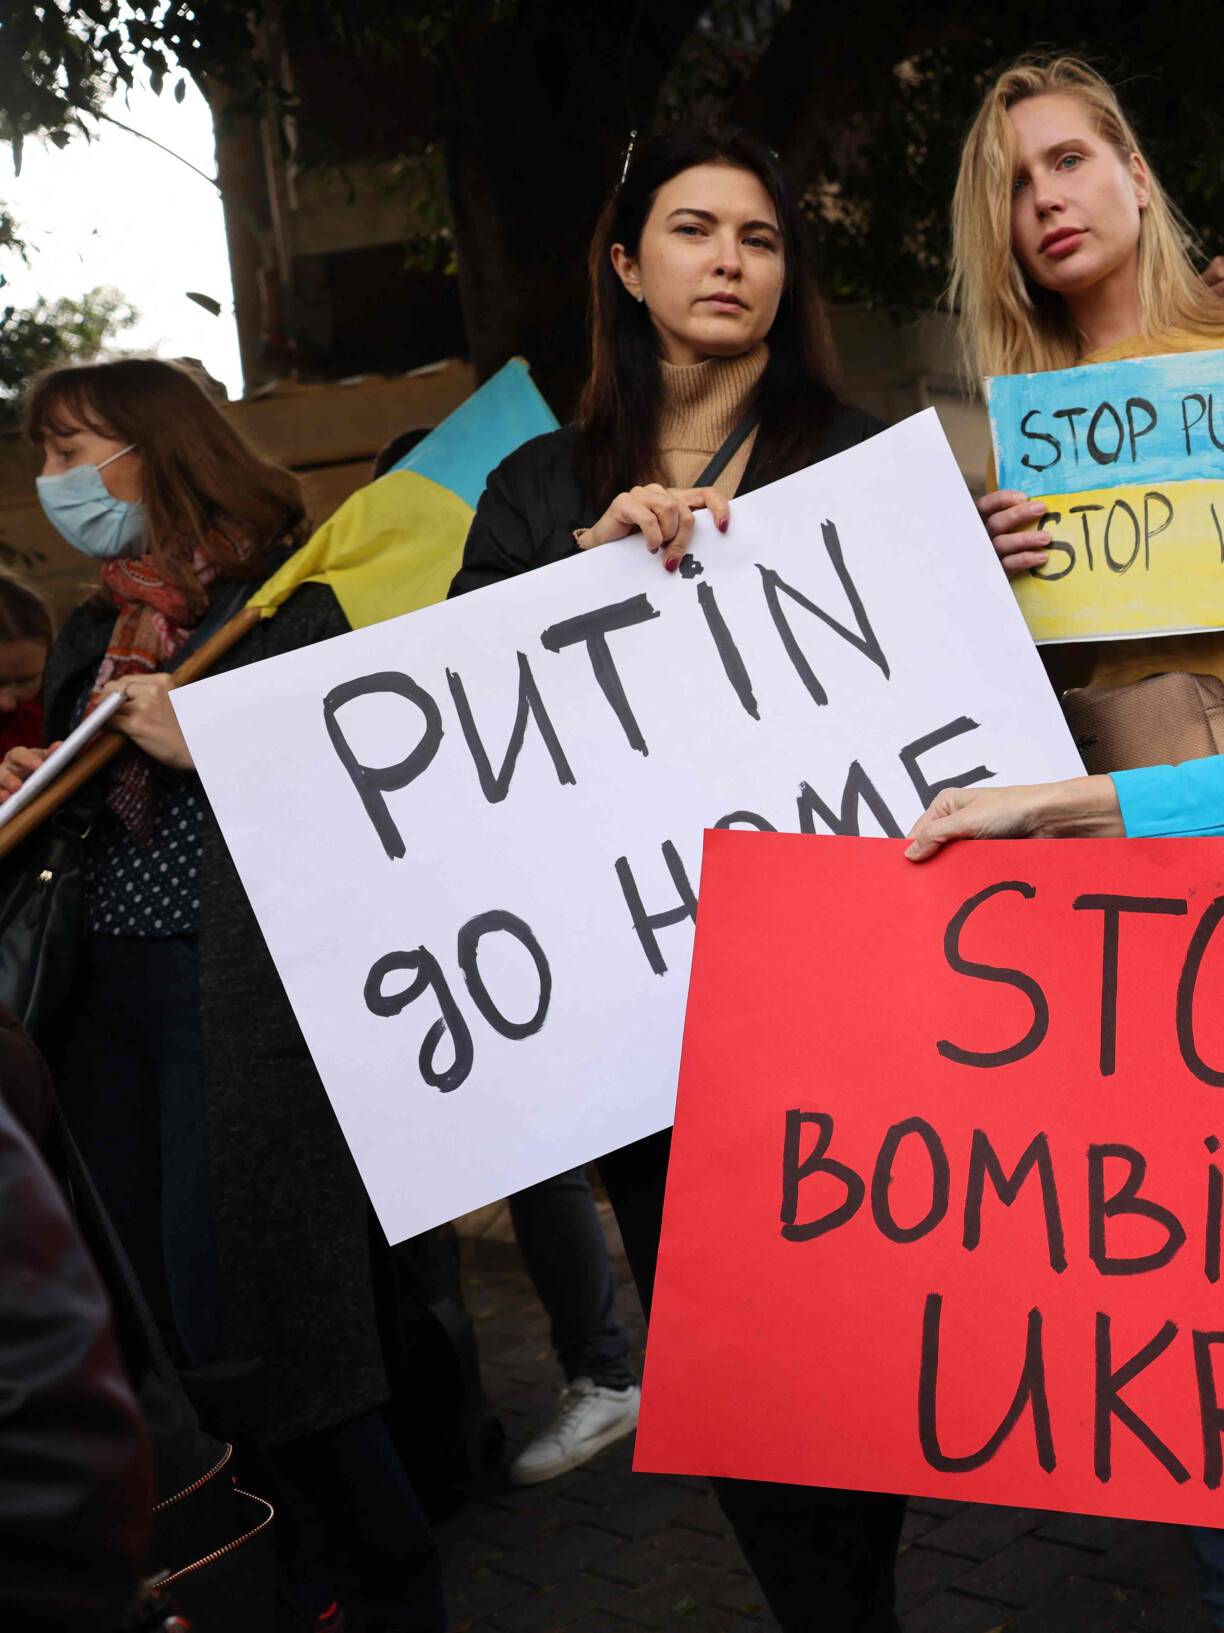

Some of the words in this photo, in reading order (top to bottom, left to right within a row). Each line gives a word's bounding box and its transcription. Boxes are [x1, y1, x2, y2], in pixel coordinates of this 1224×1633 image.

[1020, 397, 1158, 472] STOP
[1028, 491, 1174, 581] STOP
[614, 715, 998, 977] HME
